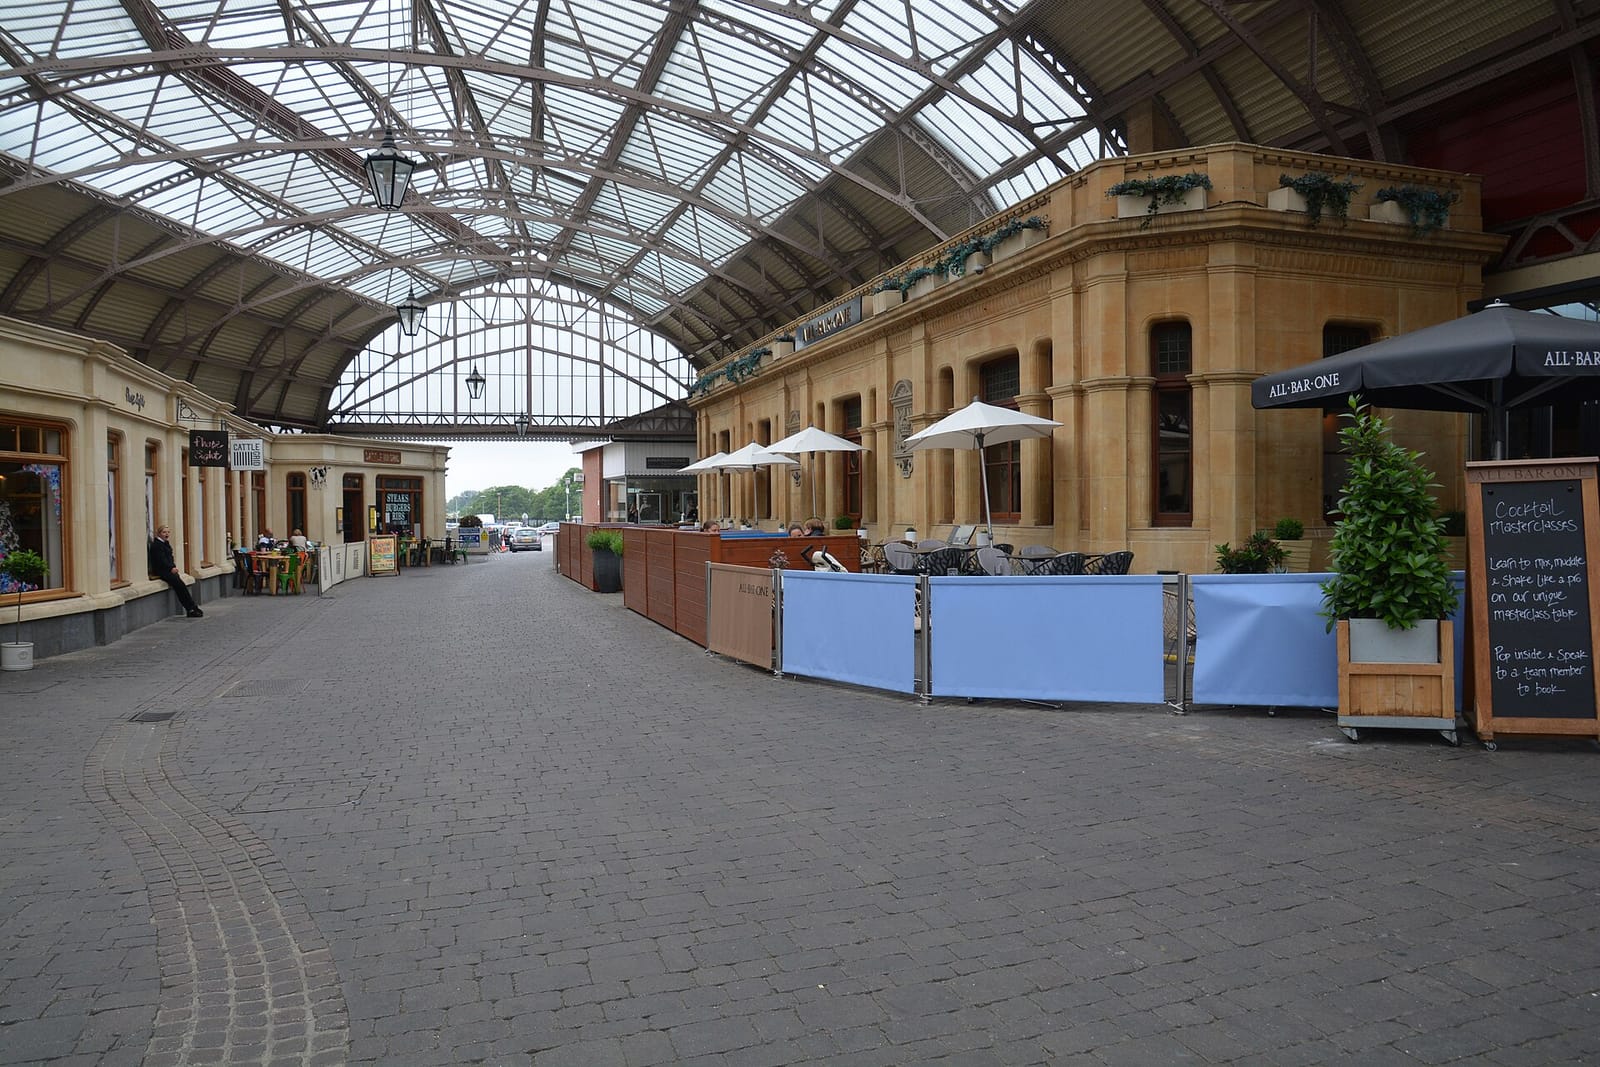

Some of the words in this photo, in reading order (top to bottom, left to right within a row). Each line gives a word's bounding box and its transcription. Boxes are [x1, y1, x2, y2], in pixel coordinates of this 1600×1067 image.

[233, 443, 261, 451] CATTLE
[252, 451, 261, 467] GRID
[386, 493, 409, 502] STEAKS
[385, 503, 411, 512] BURGERS
[1495, 498, 1565, 519] Cocktail
[1490, 557, 1517, 571] Learn
[1518, 558, 1531, 571] to
[1558, 576, 1565, 584] a
[1567, 573, 1582, 587] pro
[1491, 593, 1506, 603] on
[1512, 592, 1527, 603] our
[1533, 591, 1567, 606] unique
[1551, 608, 1578, 622] table
[1494, 646, 1511, 663] Pop
[1514, 648, 1546, 661] inside
[1496, 666, 1508, 680] to
[1510, 669, 1520, 678] a
[1523, 667, 1547, 680] team
[1550, 665, 1586, 678] member
[1517, 682, 1530, 697] to
